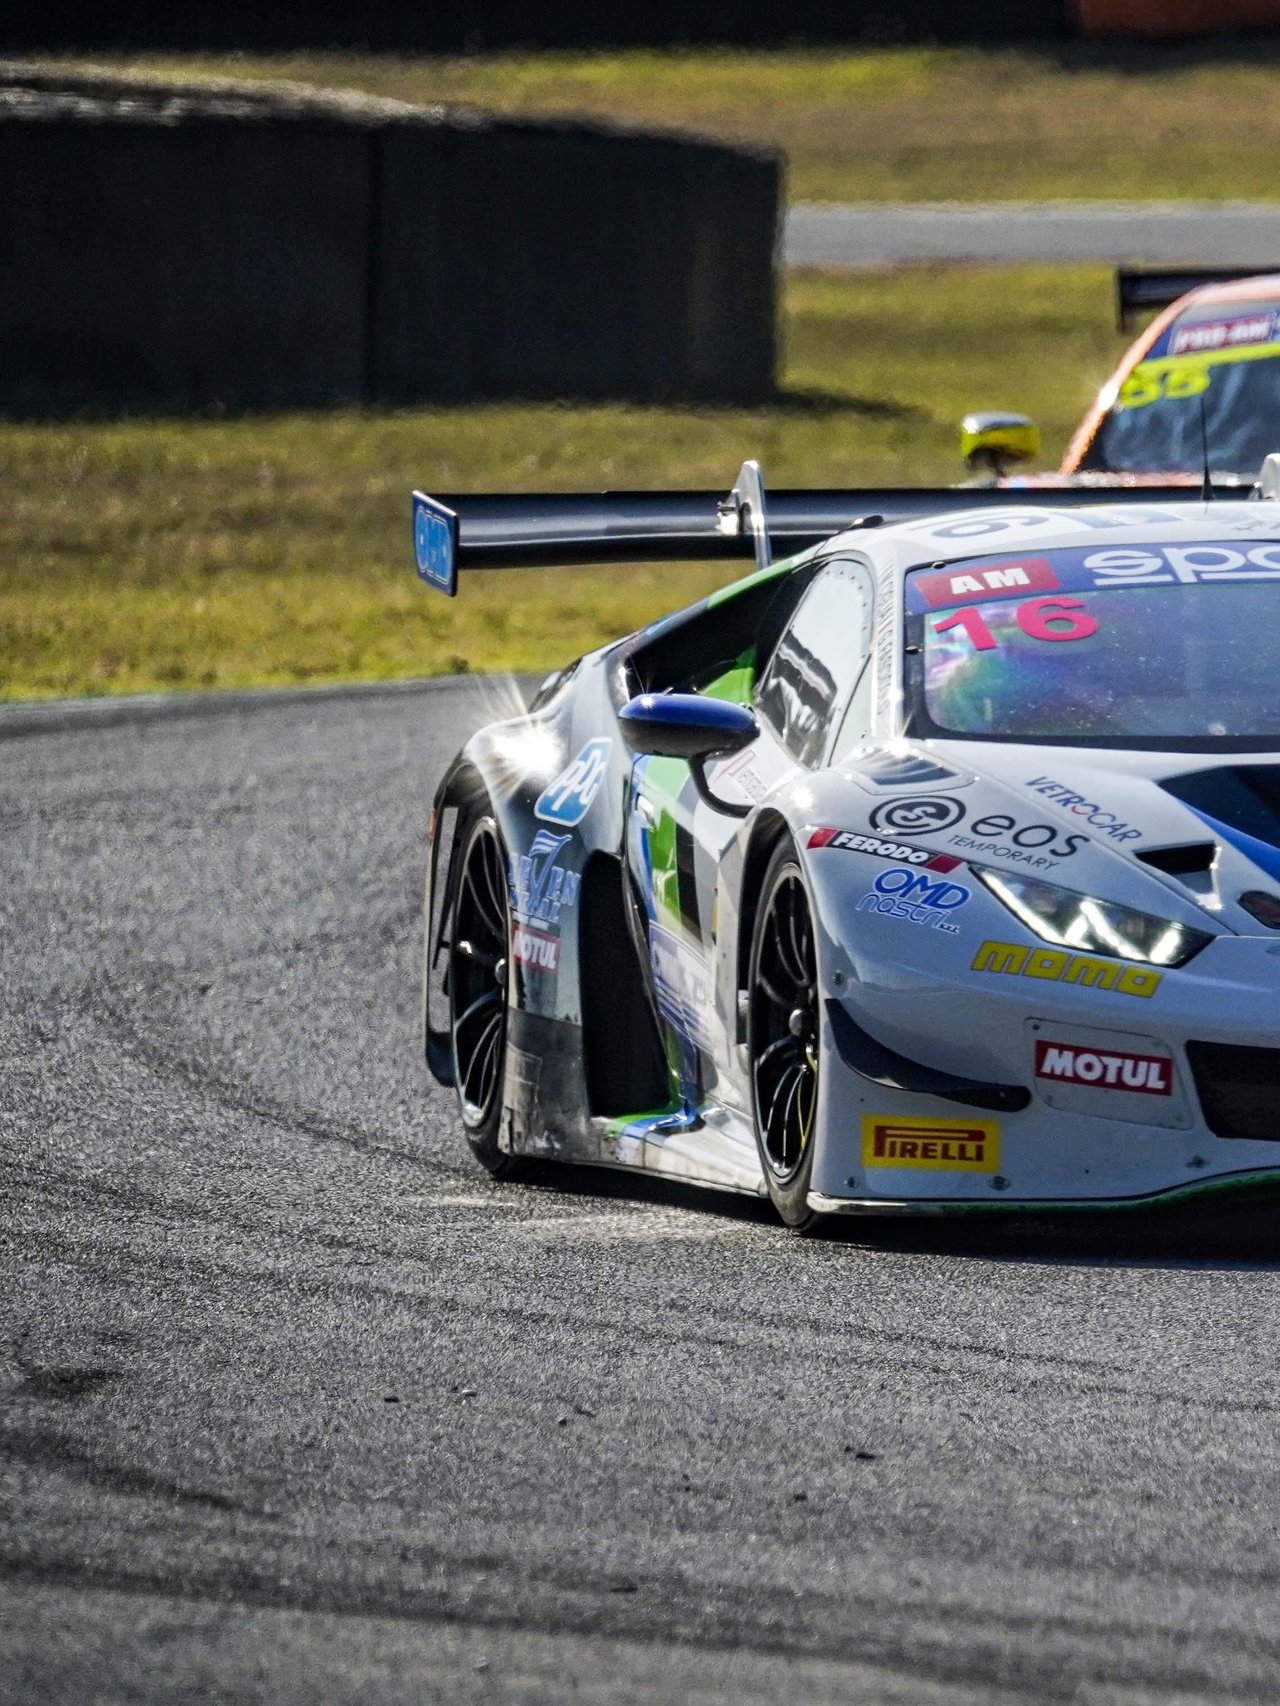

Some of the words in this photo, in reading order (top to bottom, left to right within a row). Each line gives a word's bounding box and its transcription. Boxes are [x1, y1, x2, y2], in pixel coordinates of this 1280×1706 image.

[950, 568, 1031, 595] AM
[933, 597, 1098, 651] 16
[1025, 776, 1142, 843] VETROCAR
[832, 834, 929, 864] FERODO
[947, 834, 1063, 871] TEMPORARY
[971, 815, 1092, 858] eos
[874, 868, 970, 910] OMD
[856, 894, 950, 928] nastri
[971, 940, 1164, 998] momo
[1041, 1047, 1167, 1090] MOTUL
[873, 1124, 987, 1162] PIRELLI
